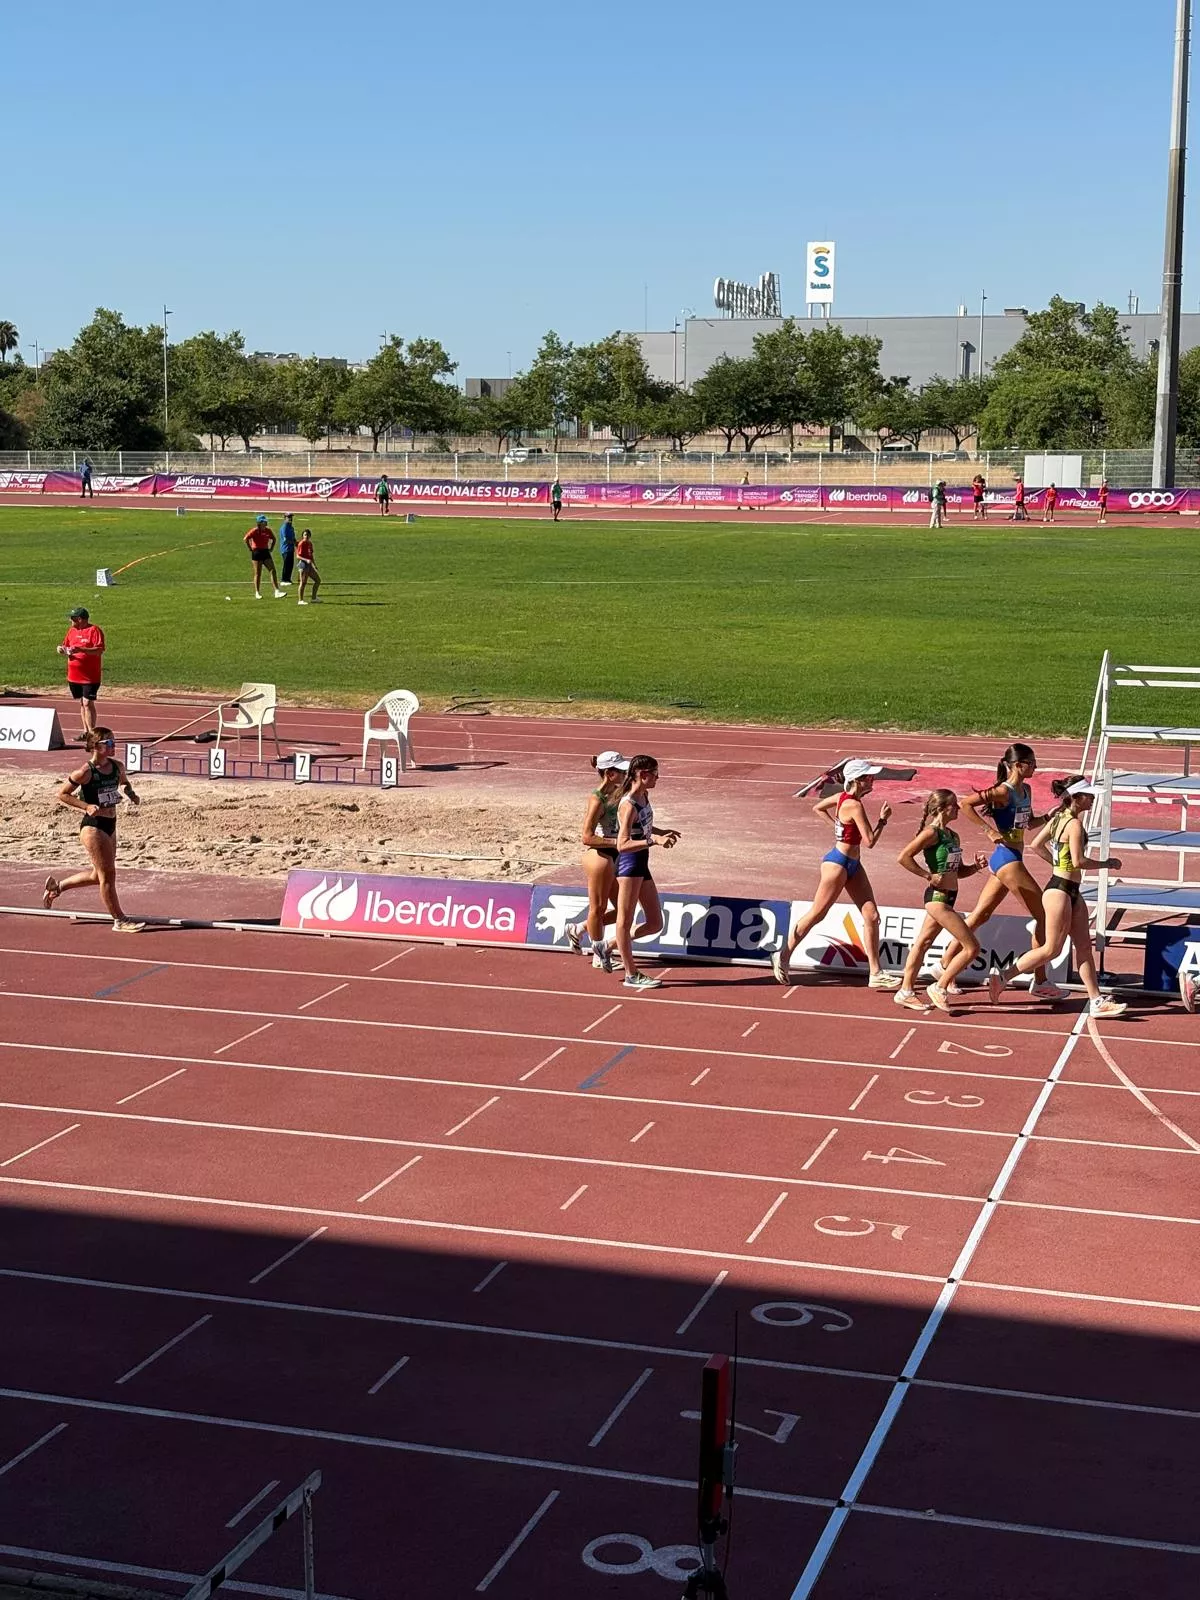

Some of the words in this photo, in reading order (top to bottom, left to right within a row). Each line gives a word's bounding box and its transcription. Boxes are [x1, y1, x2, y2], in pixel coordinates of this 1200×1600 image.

[175, 476, 205, 486] Allianz
[206, 477, 239, 487] Futures
[240, 478, 250, 487] 32
[267, 480, 312, 494] Allianz
[413, 485, 491, 498] NACIONALES
[494, 486, 537, 498] SUB-18
[846, 491, 887, 502] Iberdrola
[1059, 498, 1102, 508] infispor
[129, 746, 137, 763] 5
[213, 751, 221, 769] 6
[299, 755, 306, 772] 7
[385, 760, 393, 778] 8
[363, 890, 516, 932] Iberdrola
[937, 1040, 1014, 1057] 2
[904, 1090, 985, 1108] 3
[861, 1147, 947, 1166] 4
[814, 1215, 911, 1241] 5
[750, 1301, 854, 1332] 6
[582, 1533, 716, 1581] 8
